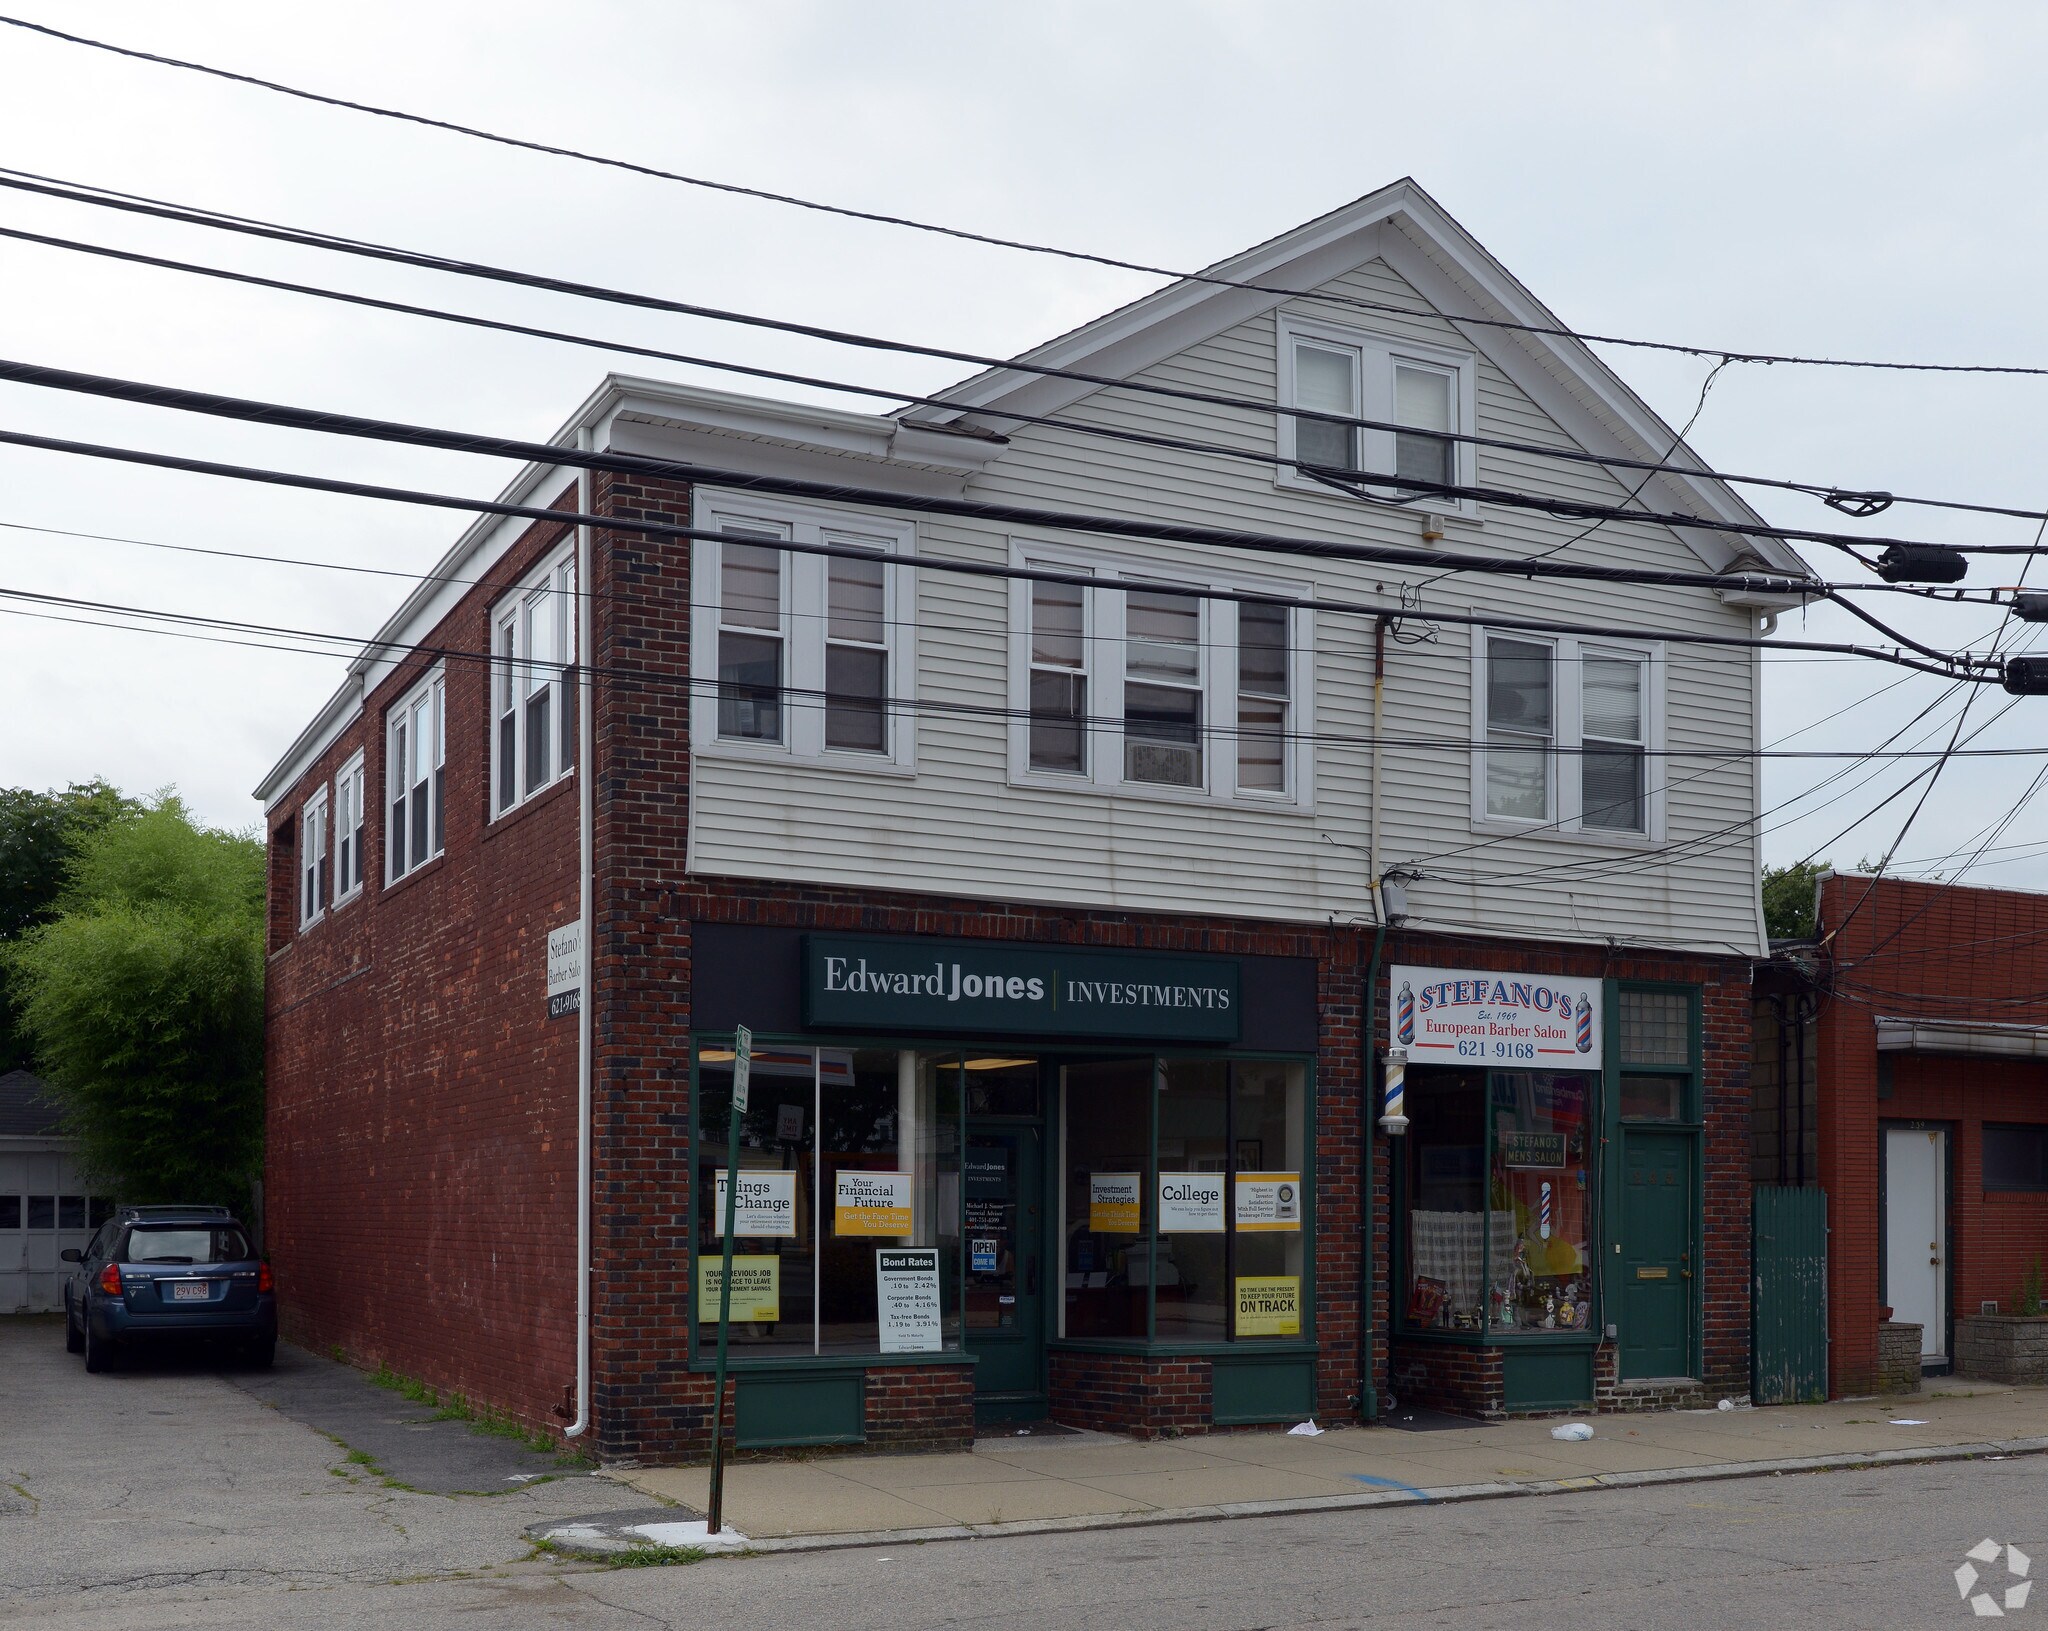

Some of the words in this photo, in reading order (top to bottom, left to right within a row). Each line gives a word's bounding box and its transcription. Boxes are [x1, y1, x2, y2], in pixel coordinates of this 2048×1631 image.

[549, 966, 568, 986] Barber
[569, 959, 581, 979] Salo
[1067, 980, 1231, 1009] INVESTMENTS
[1420, 980, 1572, 1020] STEFANO'S
[1477, 1010, 1492, 1021] Est.
[1496, 1011, 1517, 1021] 1969
[1426, 1018, 1486, 1037] European
[1489, 1022, 1531, 1037] Barber
[1534, 1024, 1568, 1039] Salon
[1457, 1040, 1486, 1057] 621
[1513, 1136, 1558, 1149] STEFANO'S
[1535, 1152, 1562, 1163] SALON
[717, 1179, 770, 1196] Tings
[852, 1178, 873, 1187] Your
[838, 1184, 894, 1196] Financial
[1093, 1185, 1132, 1194] Investment
[1162, 1185, 1219, 1204] College
[735, 1195, 790, 1212] Change
[853, 1197, 894, 1208] Future
[1098, 1194, 1137, 1206] Strategies
[843, 1211, 858, 1220] Get
[859, 1211, 871, 1220] the
[872, 1212, 889, 1220] Face
[890, 1213, 909, 1221] Time
[863, 1220, 877, 1228] You
[878, 1220, 909, 1229] Deserve
[974, 1242, 996, 1253] OPEN
[882, 1257, 905, 1267] Bond
[908, 1257, 934, 1267] Rates
[974, 1258, 989, 1266] COME
[705, 1270, 722, 1278] YOUR
[730, 1269, 757, 1277] REVIOUS
[759, 1269, 771, 1277] JOB
[176, 1286, 193, 1296] 29V
[193, 1286, 208, 1296] C98
[1240, 1300, 1256, 1313] ON
[1258, 1299, 1297, 1312] TRACK.
